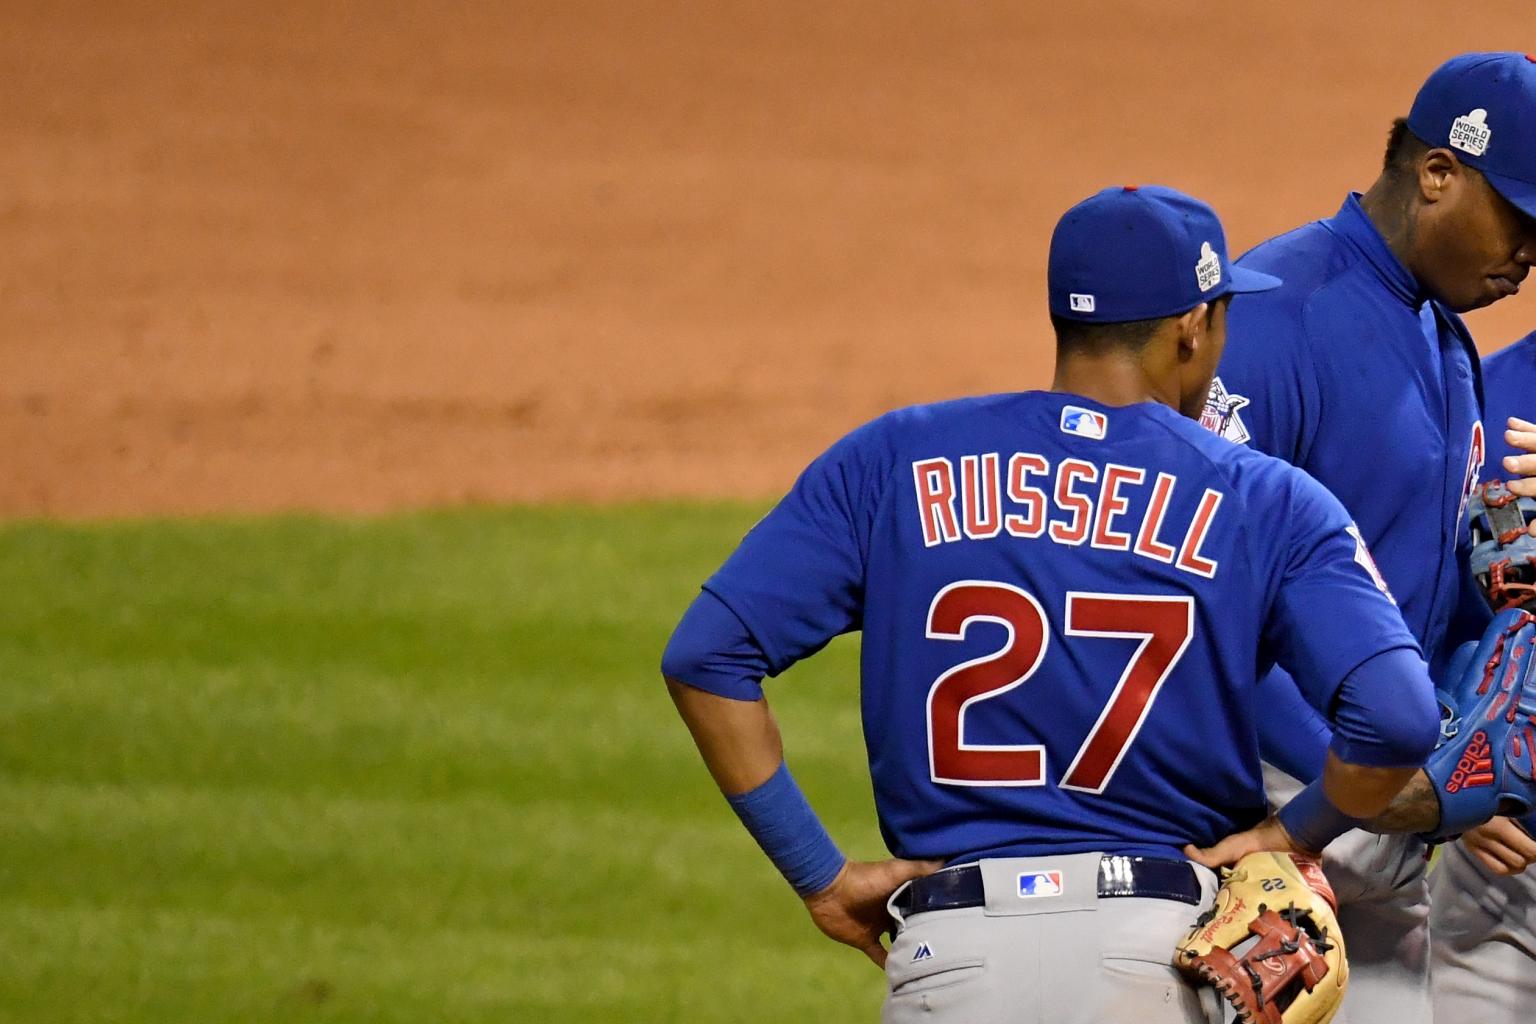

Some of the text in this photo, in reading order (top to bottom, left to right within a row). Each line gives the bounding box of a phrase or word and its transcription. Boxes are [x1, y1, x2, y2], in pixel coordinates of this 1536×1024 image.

[1451, 129, 1485, 150] SERIES
[1455, 120, 1488, 139] WORLD
[912, 452, 1223, 579] RUSSELL
[925, 580, 1195, 795] 27
[1446, 731, 1487, 793] adidas
